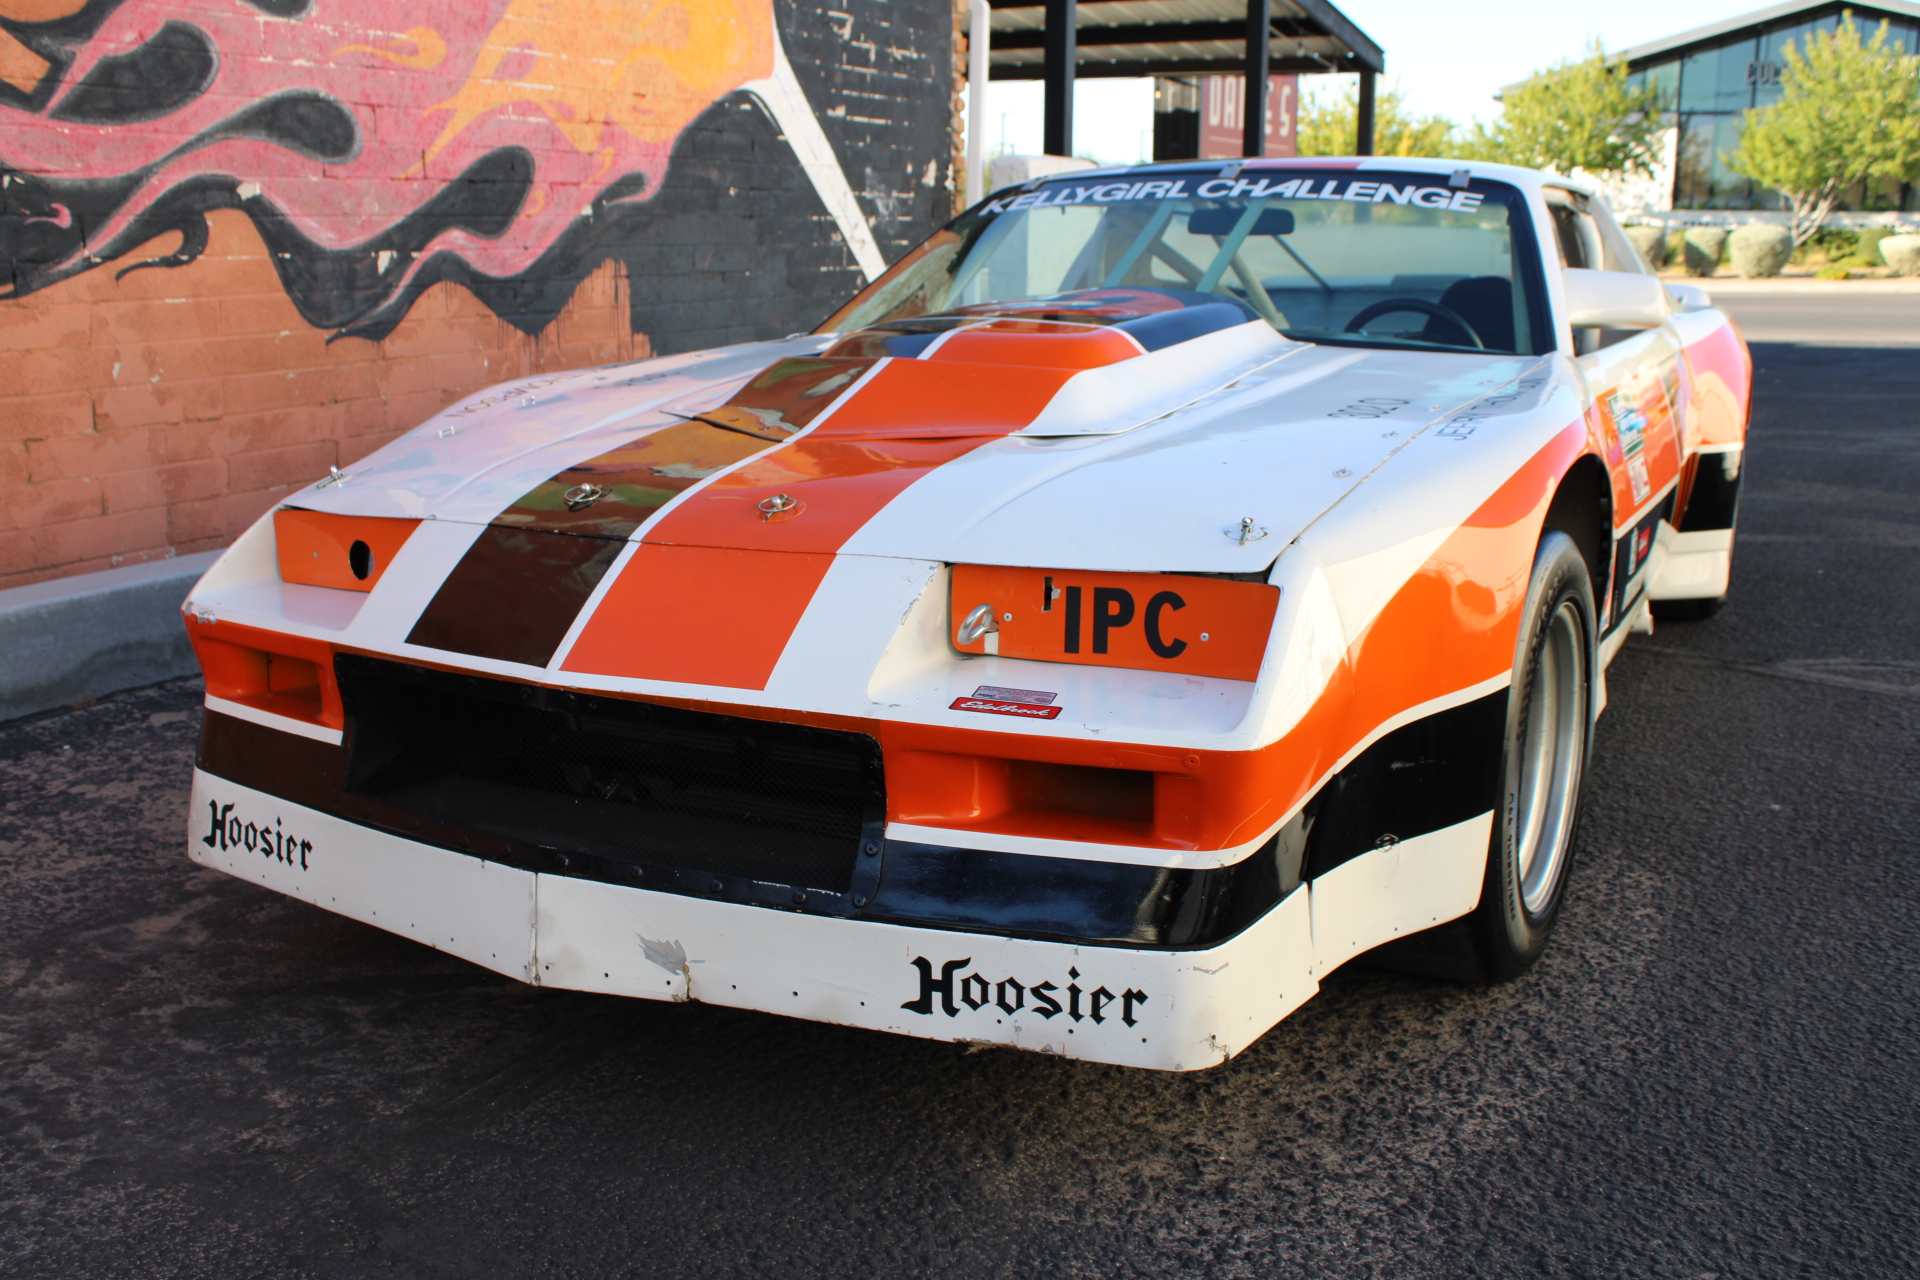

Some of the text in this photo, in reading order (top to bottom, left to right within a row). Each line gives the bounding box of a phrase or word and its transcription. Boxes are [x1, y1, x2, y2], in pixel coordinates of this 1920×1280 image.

[1746, 61, 1782, 86] CUL
[978, 179, 1486, 217] KELLYGIRL CHALLENGE
[1064, 586, 1188, 659] IPC
[960, 701, 1051, 716] Edelbrock
[202, 799, 313, 872] Hoosier
[900, 955, 1150, 1028] Hoosier
